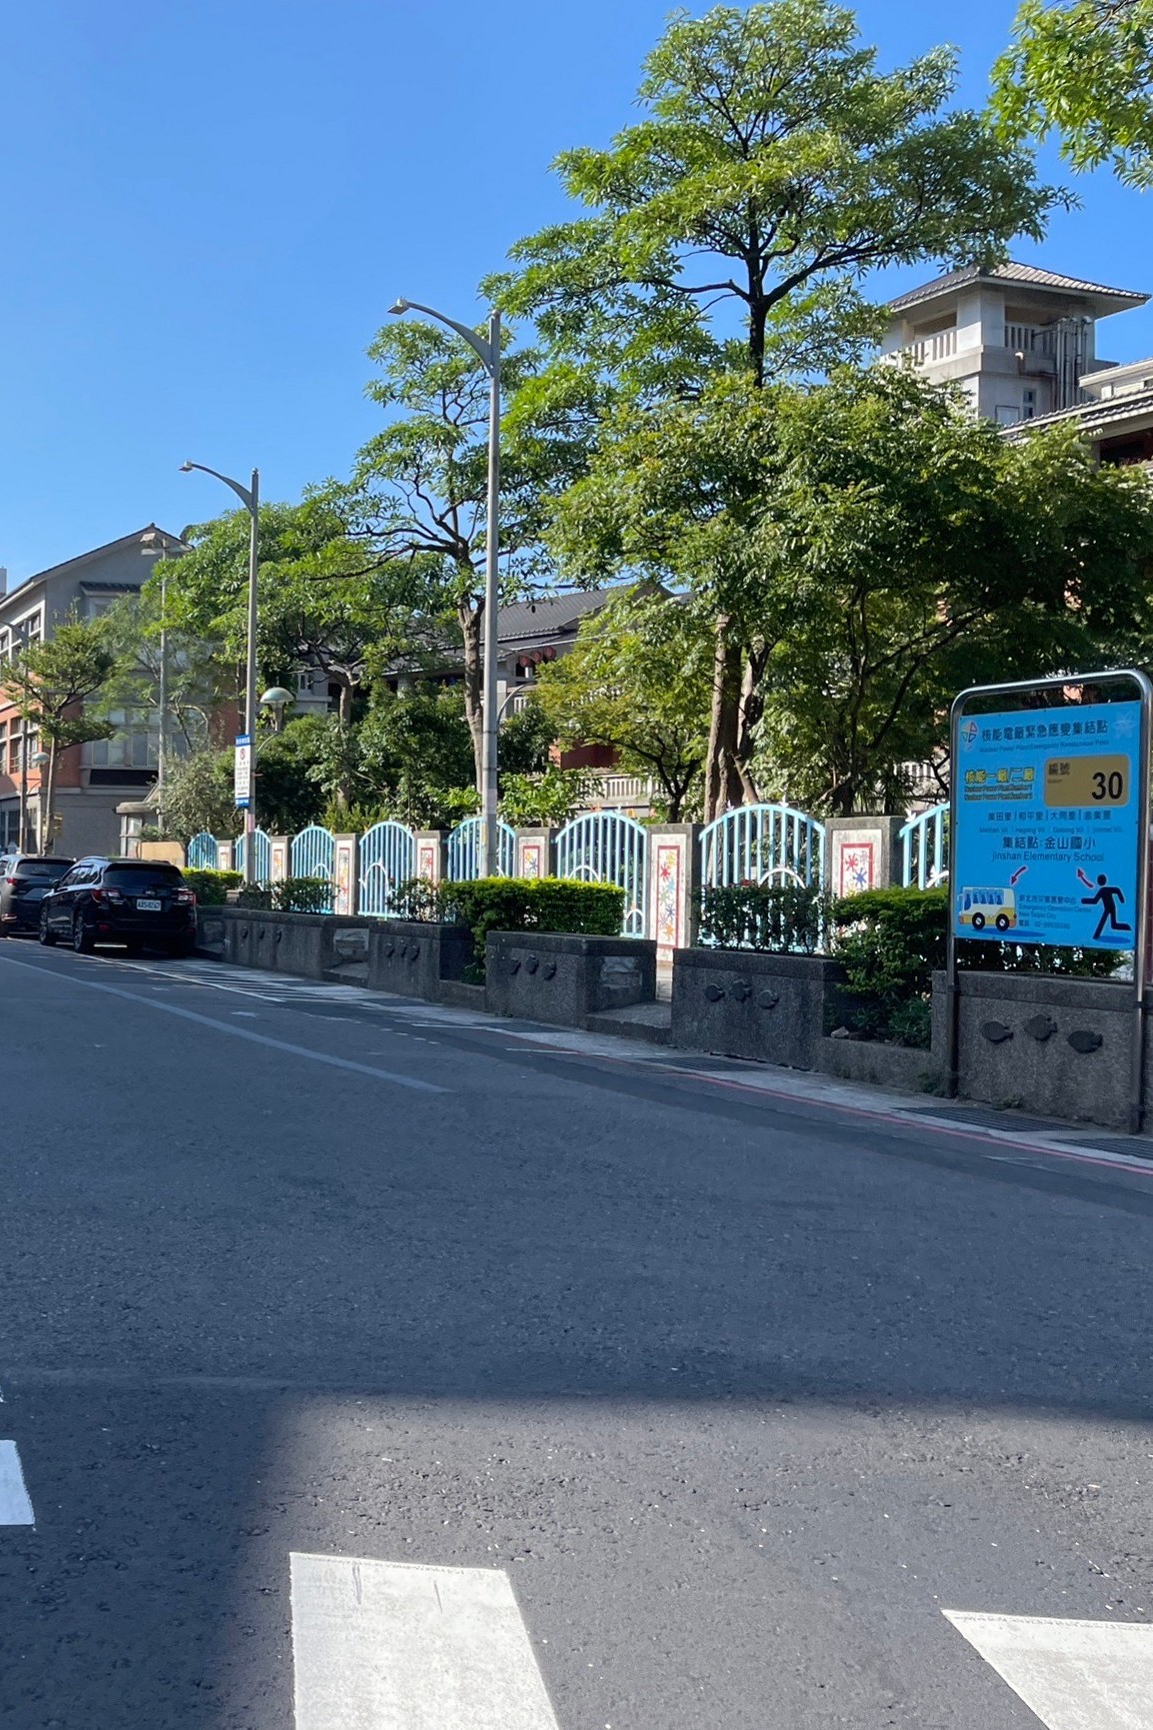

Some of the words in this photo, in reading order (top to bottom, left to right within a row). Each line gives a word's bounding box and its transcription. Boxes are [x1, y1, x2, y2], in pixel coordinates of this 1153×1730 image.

[1091, 771, 1124, 801] 30
[1023, 851, 1072, 863] Elementary
[1073, 852, 1105, 862] School
